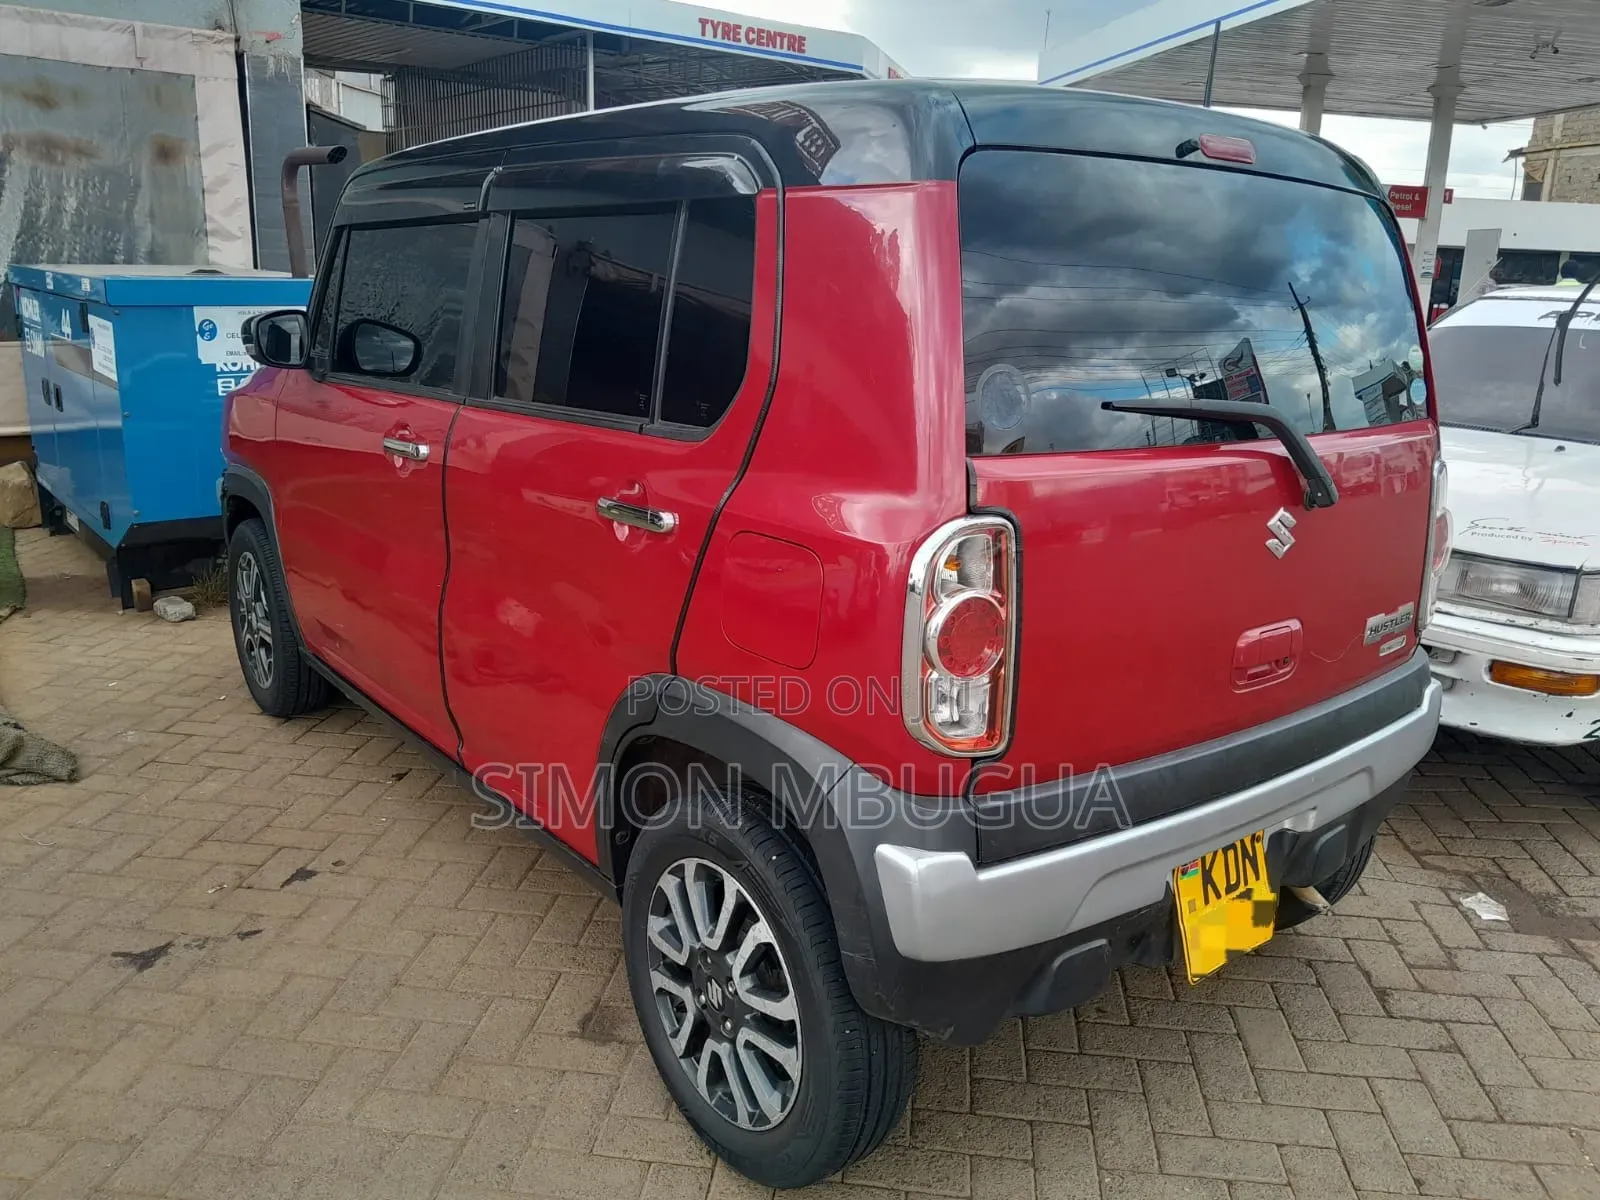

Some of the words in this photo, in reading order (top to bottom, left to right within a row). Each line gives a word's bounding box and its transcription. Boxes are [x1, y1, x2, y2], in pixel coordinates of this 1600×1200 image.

[698, 17, 742, 44] TYRE
[744, 26, 806, 54] CENTRE
[1390, 191, 1413, 200] Petrol
[1471, 530, 1519, 541] Produced
[1368, 610, 1413, 637] HUSTLER
[1200, 835, 1261, 906] KDN
